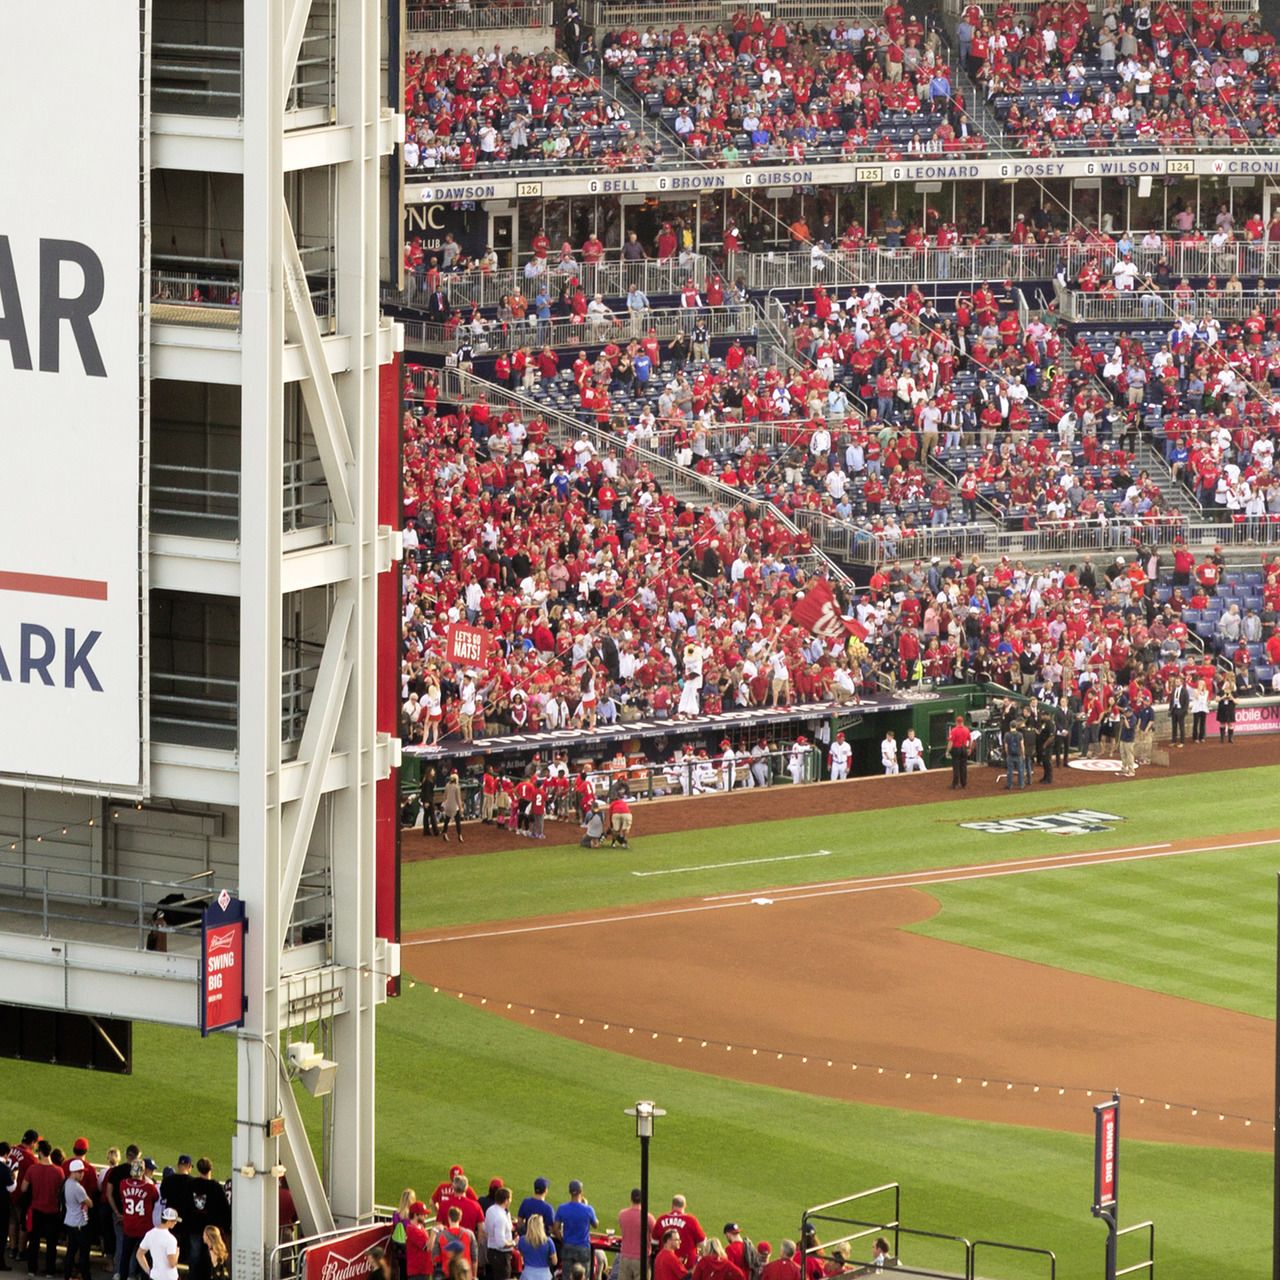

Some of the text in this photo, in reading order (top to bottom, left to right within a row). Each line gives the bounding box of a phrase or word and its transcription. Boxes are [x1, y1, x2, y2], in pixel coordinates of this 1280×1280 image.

[906, 166, 979, 179] LEONARD
[1014, 164, 1065, 175] POSEY
[1100, 161, 1160, 173] WILSON
[1171, 162, 1189, 172] 124
[758, 172, 813, 184] GIBSON
[860, 170, 878, 180] 125
[603, 179, 638, 192] BELL
[672, 176, 725, 188] BROWN
[435, 185, 495, 200] DAWSON
[520, 185, 538, 195] 126
[455, 630, 481, 645] LET'S GO
[454, 641, 481, 661] NATS!
[208, 951, 234, 972] SWING
[208, 973, 223, 991] BIG
[122, 1188, 147, 1201] HARPER
[124, 1199, 145, 1216] 34
